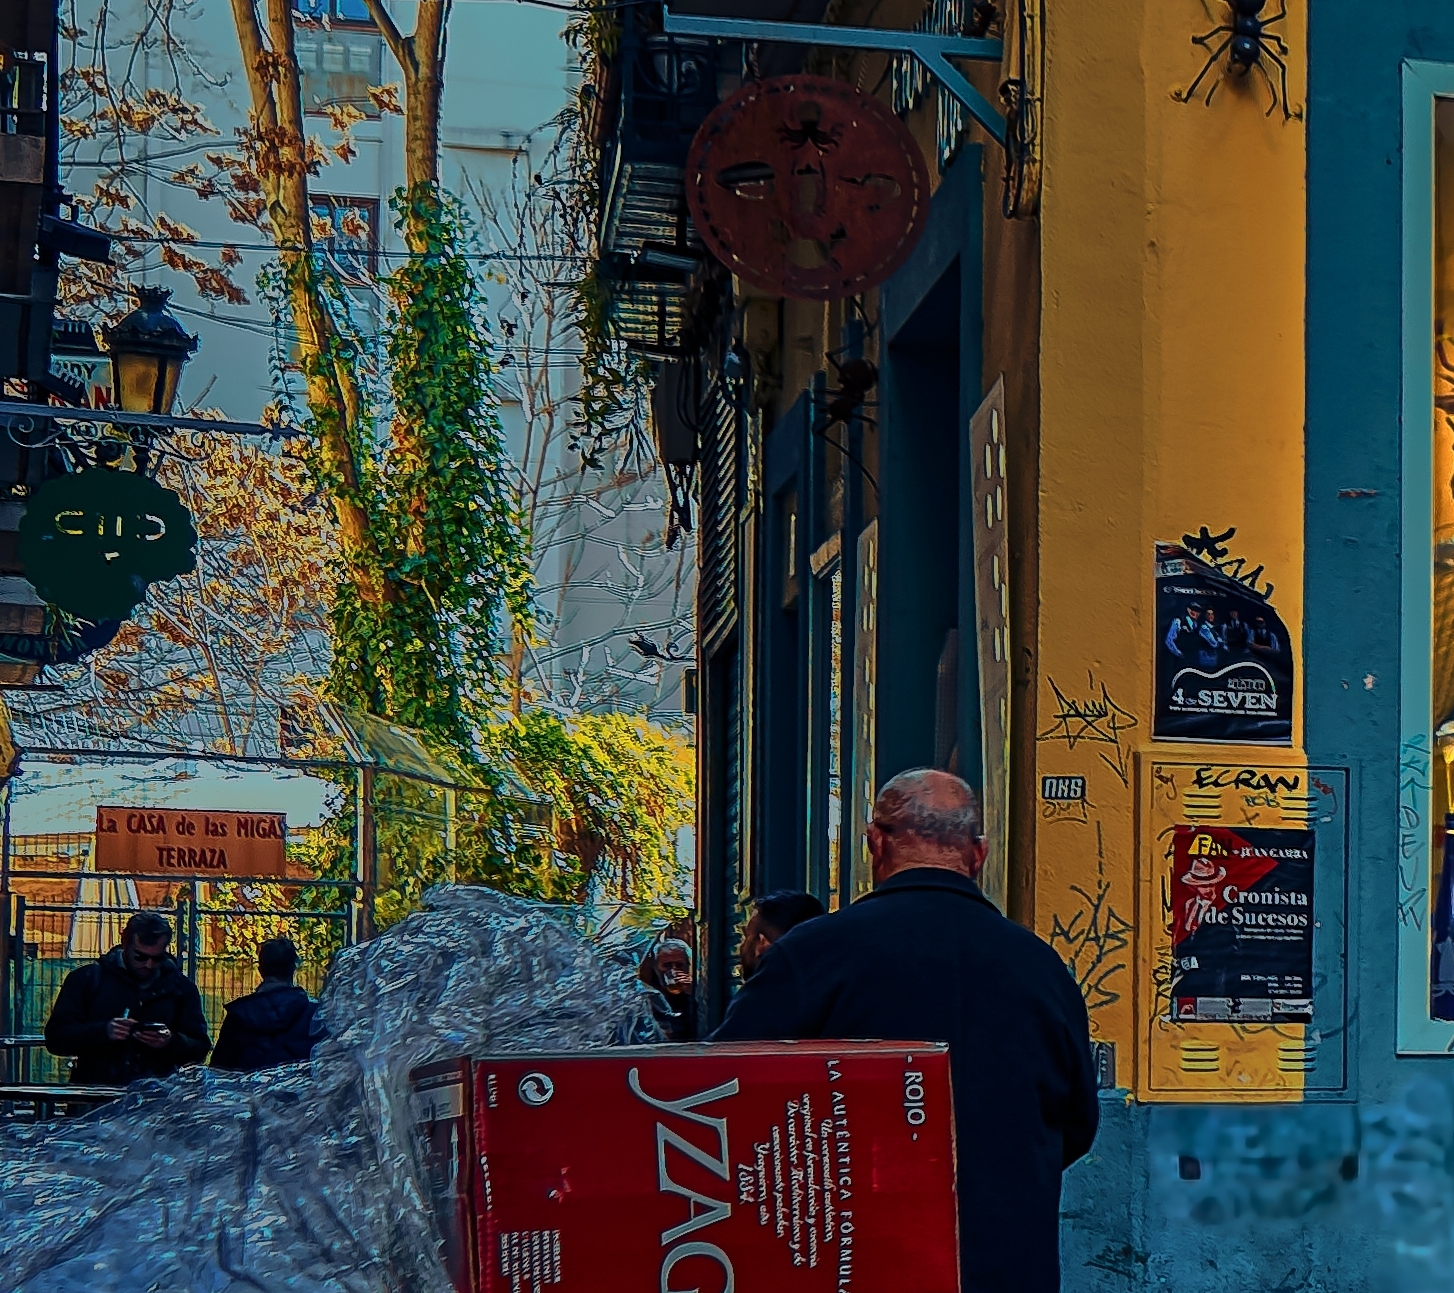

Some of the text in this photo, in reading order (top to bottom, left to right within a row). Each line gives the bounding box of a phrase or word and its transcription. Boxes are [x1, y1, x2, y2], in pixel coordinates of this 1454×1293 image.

[1198, 690, 1278, 710] SEVEN
[100, 812, 286, 840] La CASA de las MIGAS
[156, 846, 228, 869] TERRAZA
[1223, 885, 1308, 906] Cronista
[1205, 908, 1308, 927] de Sucesos
[826, 1060, 842, 1081] LA
[904, 1070, 926, 1125] ROJO
[831, 1091, 853, 1201] AUTÉNTICA
